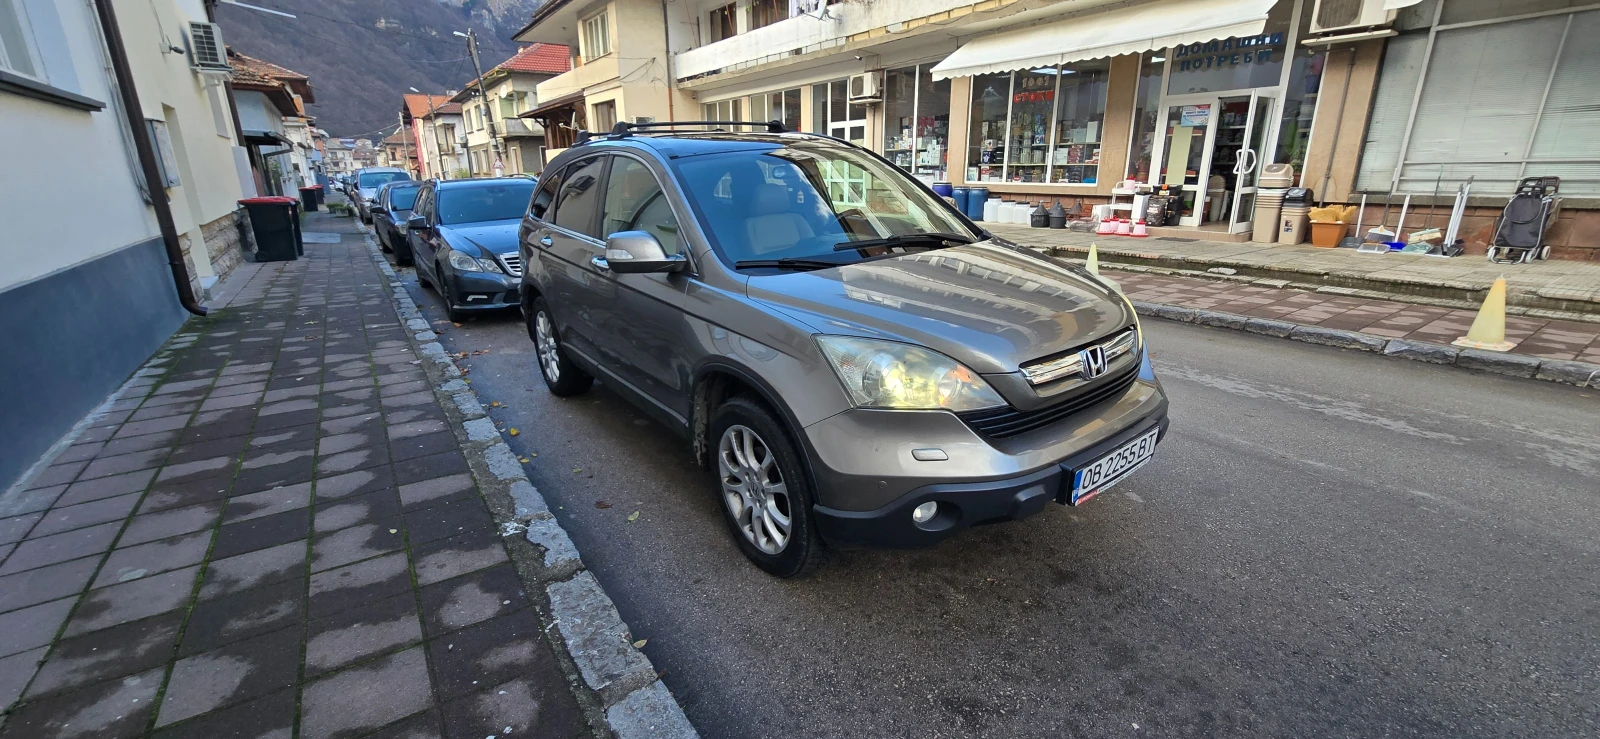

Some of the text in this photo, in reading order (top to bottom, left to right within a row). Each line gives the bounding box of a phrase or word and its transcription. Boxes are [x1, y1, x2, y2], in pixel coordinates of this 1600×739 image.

[1176, 32, 1283, 58] ДОМАШНИ
[1180, 49, 1272, 71] ПОТРЕБИ
[1014, 90, 1053, 103] СТОКИ
[1082, 463, 1102, 490] OB
[1103, 443, 1137, 479] 2255
[1137, 433, 1156, 458] BT
